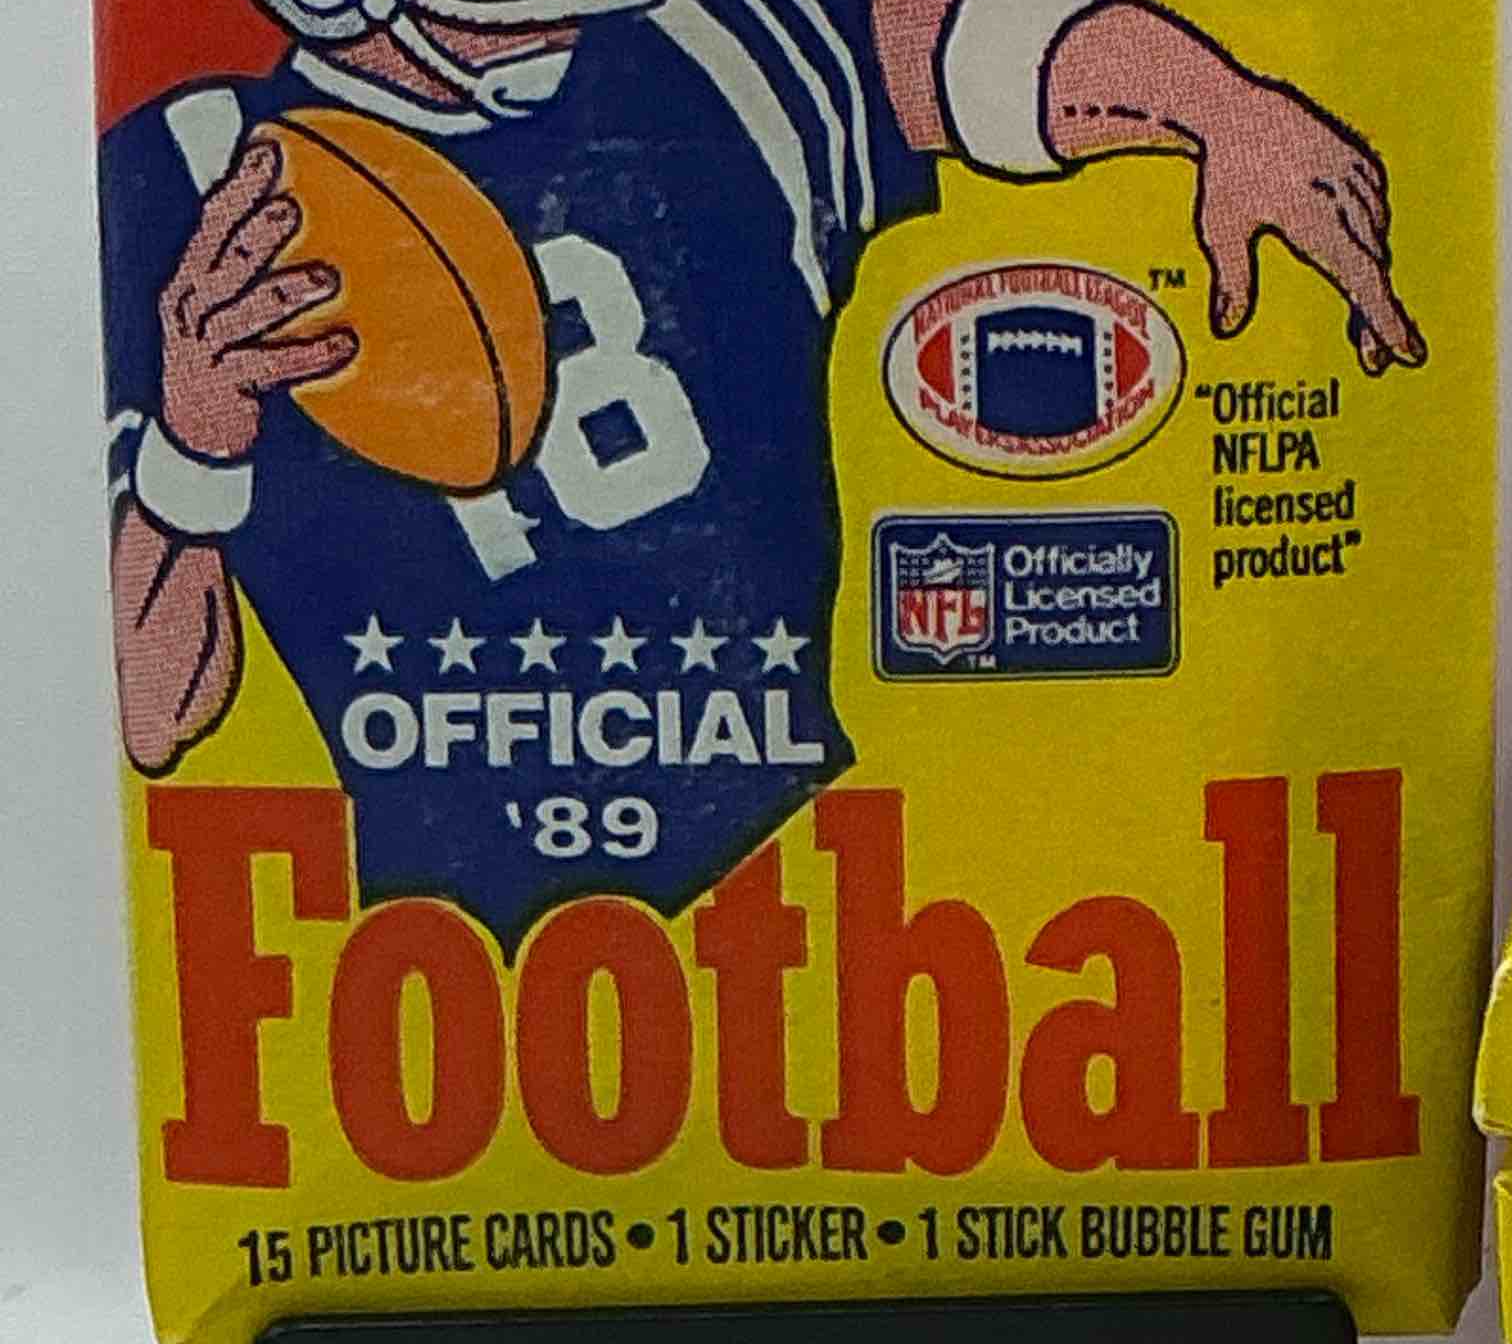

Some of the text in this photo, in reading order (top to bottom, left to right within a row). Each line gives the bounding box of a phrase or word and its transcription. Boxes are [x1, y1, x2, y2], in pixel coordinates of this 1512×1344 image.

[1149, 268, 1187, 290] TM
[1213, 430, 1322, 475] NFLPA
[1213, 478, 1356, 528] licensed
[1003, 543, 1154, 580] Officially
[898, 588, 986, 642] NFL
[1005, 577, 1162, 611] Licensed
[1005, 612, 1142, 645] Product
[340, 689, 826, 769] OFFICIAL
[505, 796, 660, 859] '89
[146, 767, 1421, 1188] Football
[237, 1203, 1334, 1288] 15 PICTURE CARDS 1 STICKER 1 STICK BUBBLE GUM
